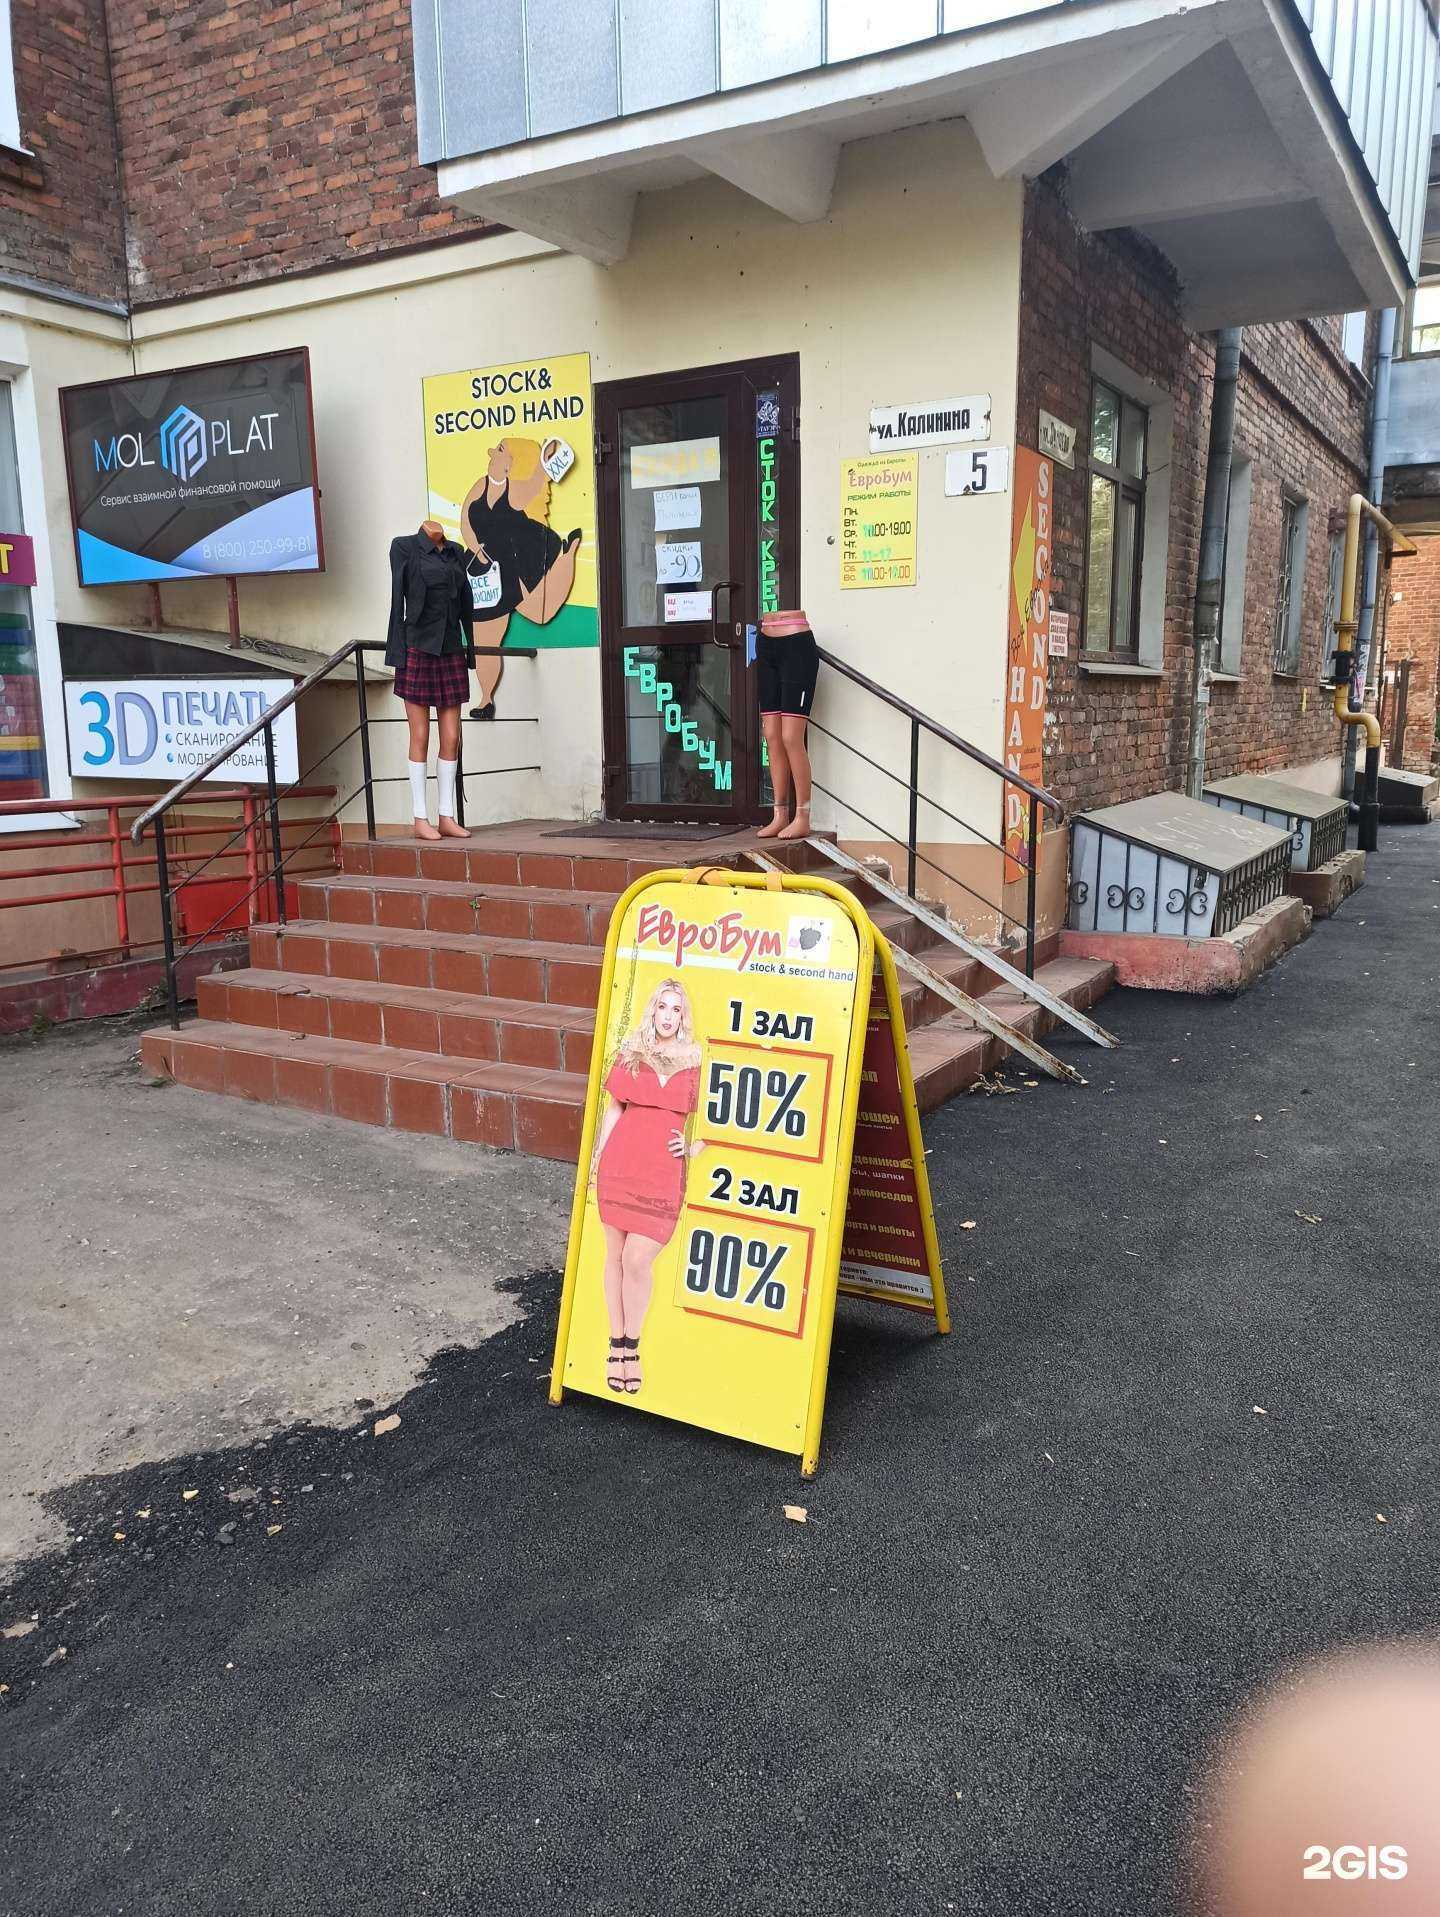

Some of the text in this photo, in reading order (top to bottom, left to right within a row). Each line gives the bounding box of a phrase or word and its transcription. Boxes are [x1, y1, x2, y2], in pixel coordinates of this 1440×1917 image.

[471, 367, 552, 399] STOCK&
[435, 395, 584, 435] SECOND HAND
[94, 412, 279, 473] MOL PLAT
[847, 468, 912, 491] ЕвроБум
[971, 451, 988, 492] 5
[100, 477, 281, 508] Сервис взаимной финансовой помощи
[847, 490, 912, 502] РЕЖИМ РАБОТЫ
[202, 543, 212, 559] 8
[214, 540, 247, 561] (800)
[1031, 461, 1049, 710] SECOND
[79, 690, 158, 767] 3D
[623, 646, 732, 790] ЕВРОБУМ
[637, 903, 782, 973] ЕвроБум
[749, 962, 855, 982] stock & second hand
[729, 1000, 743, 1032] 1
[707, 1061, 807, 1138] 50%
[710, 1167, 733, 1201] 2
[872, 1170, 905, 1182] шапки
[853, 1187, 914, 1204] домоседов
[878, 1224, 916, 1239] работы
[686, 1228, 788, 1310] 90%
[856, 1247, 921, 1268] вечеринки
